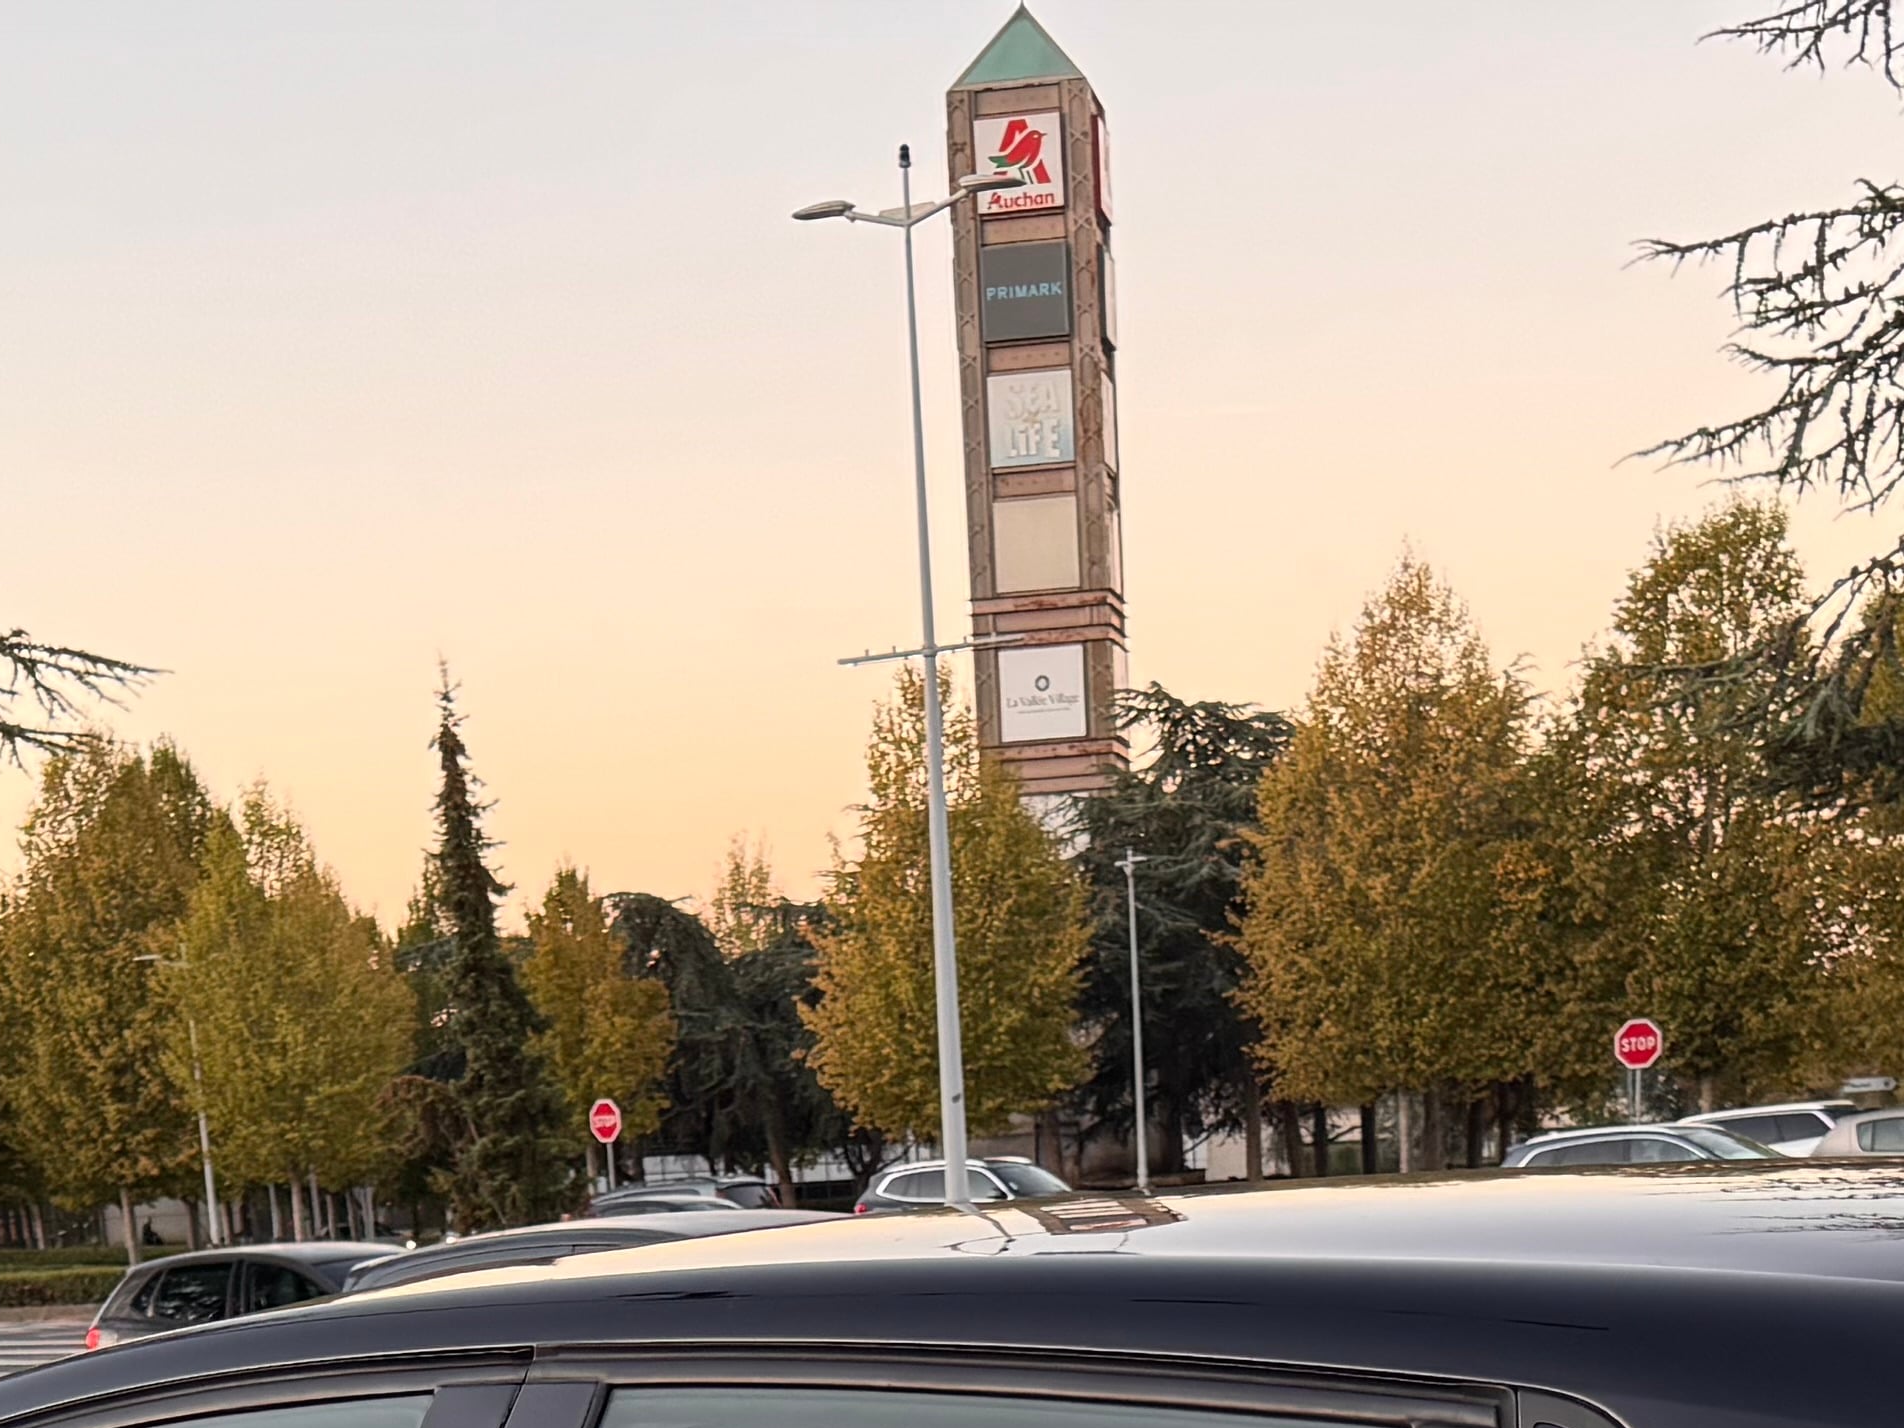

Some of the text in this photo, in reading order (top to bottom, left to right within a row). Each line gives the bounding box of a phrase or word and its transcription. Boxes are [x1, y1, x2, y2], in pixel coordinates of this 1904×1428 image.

[986, 191, 1055, 210] Auchan
[986, 281, 1063, 301] PRIMARK
[1621, 1036, 1655, 1052] STOP
